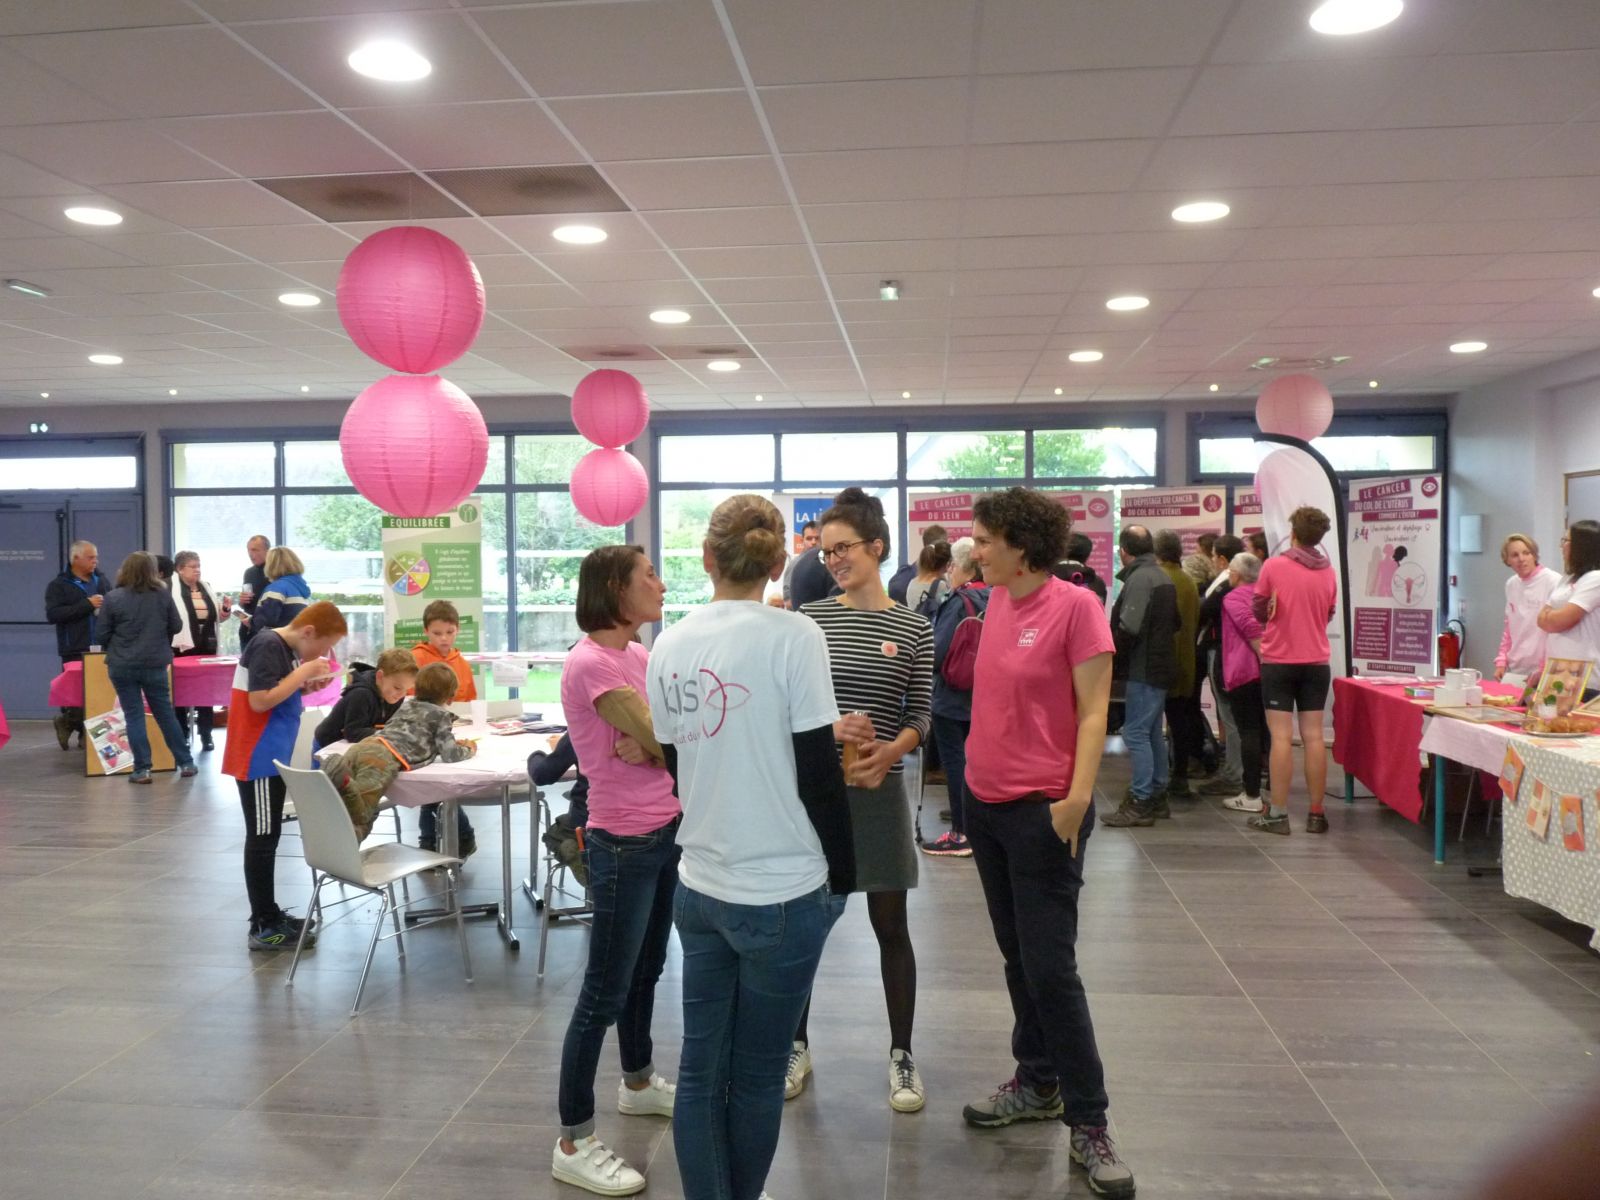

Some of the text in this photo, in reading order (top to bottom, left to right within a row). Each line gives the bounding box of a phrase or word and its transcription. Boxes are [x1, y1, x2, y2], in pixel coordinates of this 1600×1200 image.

[1363, 482, 1406, 498] LE CANCER
[920, 496, 966, 510] LE CANCER
[1171, 494, 1193, 503] CANCER
[1354, 501, 1362, 511] DU
[1363, 501, 1373, 511] COL
[1374, 500, 1382, 510] DE
[796, 512, 810, 522] LA
[928, 511, 960, 520] DU SEIN
[1127, 508, 1136, 516] DU
[1137, 508, 1147, 516] COL
[1148, 508, 1155, 516] DE
[658, 672, 699, 717] kis
